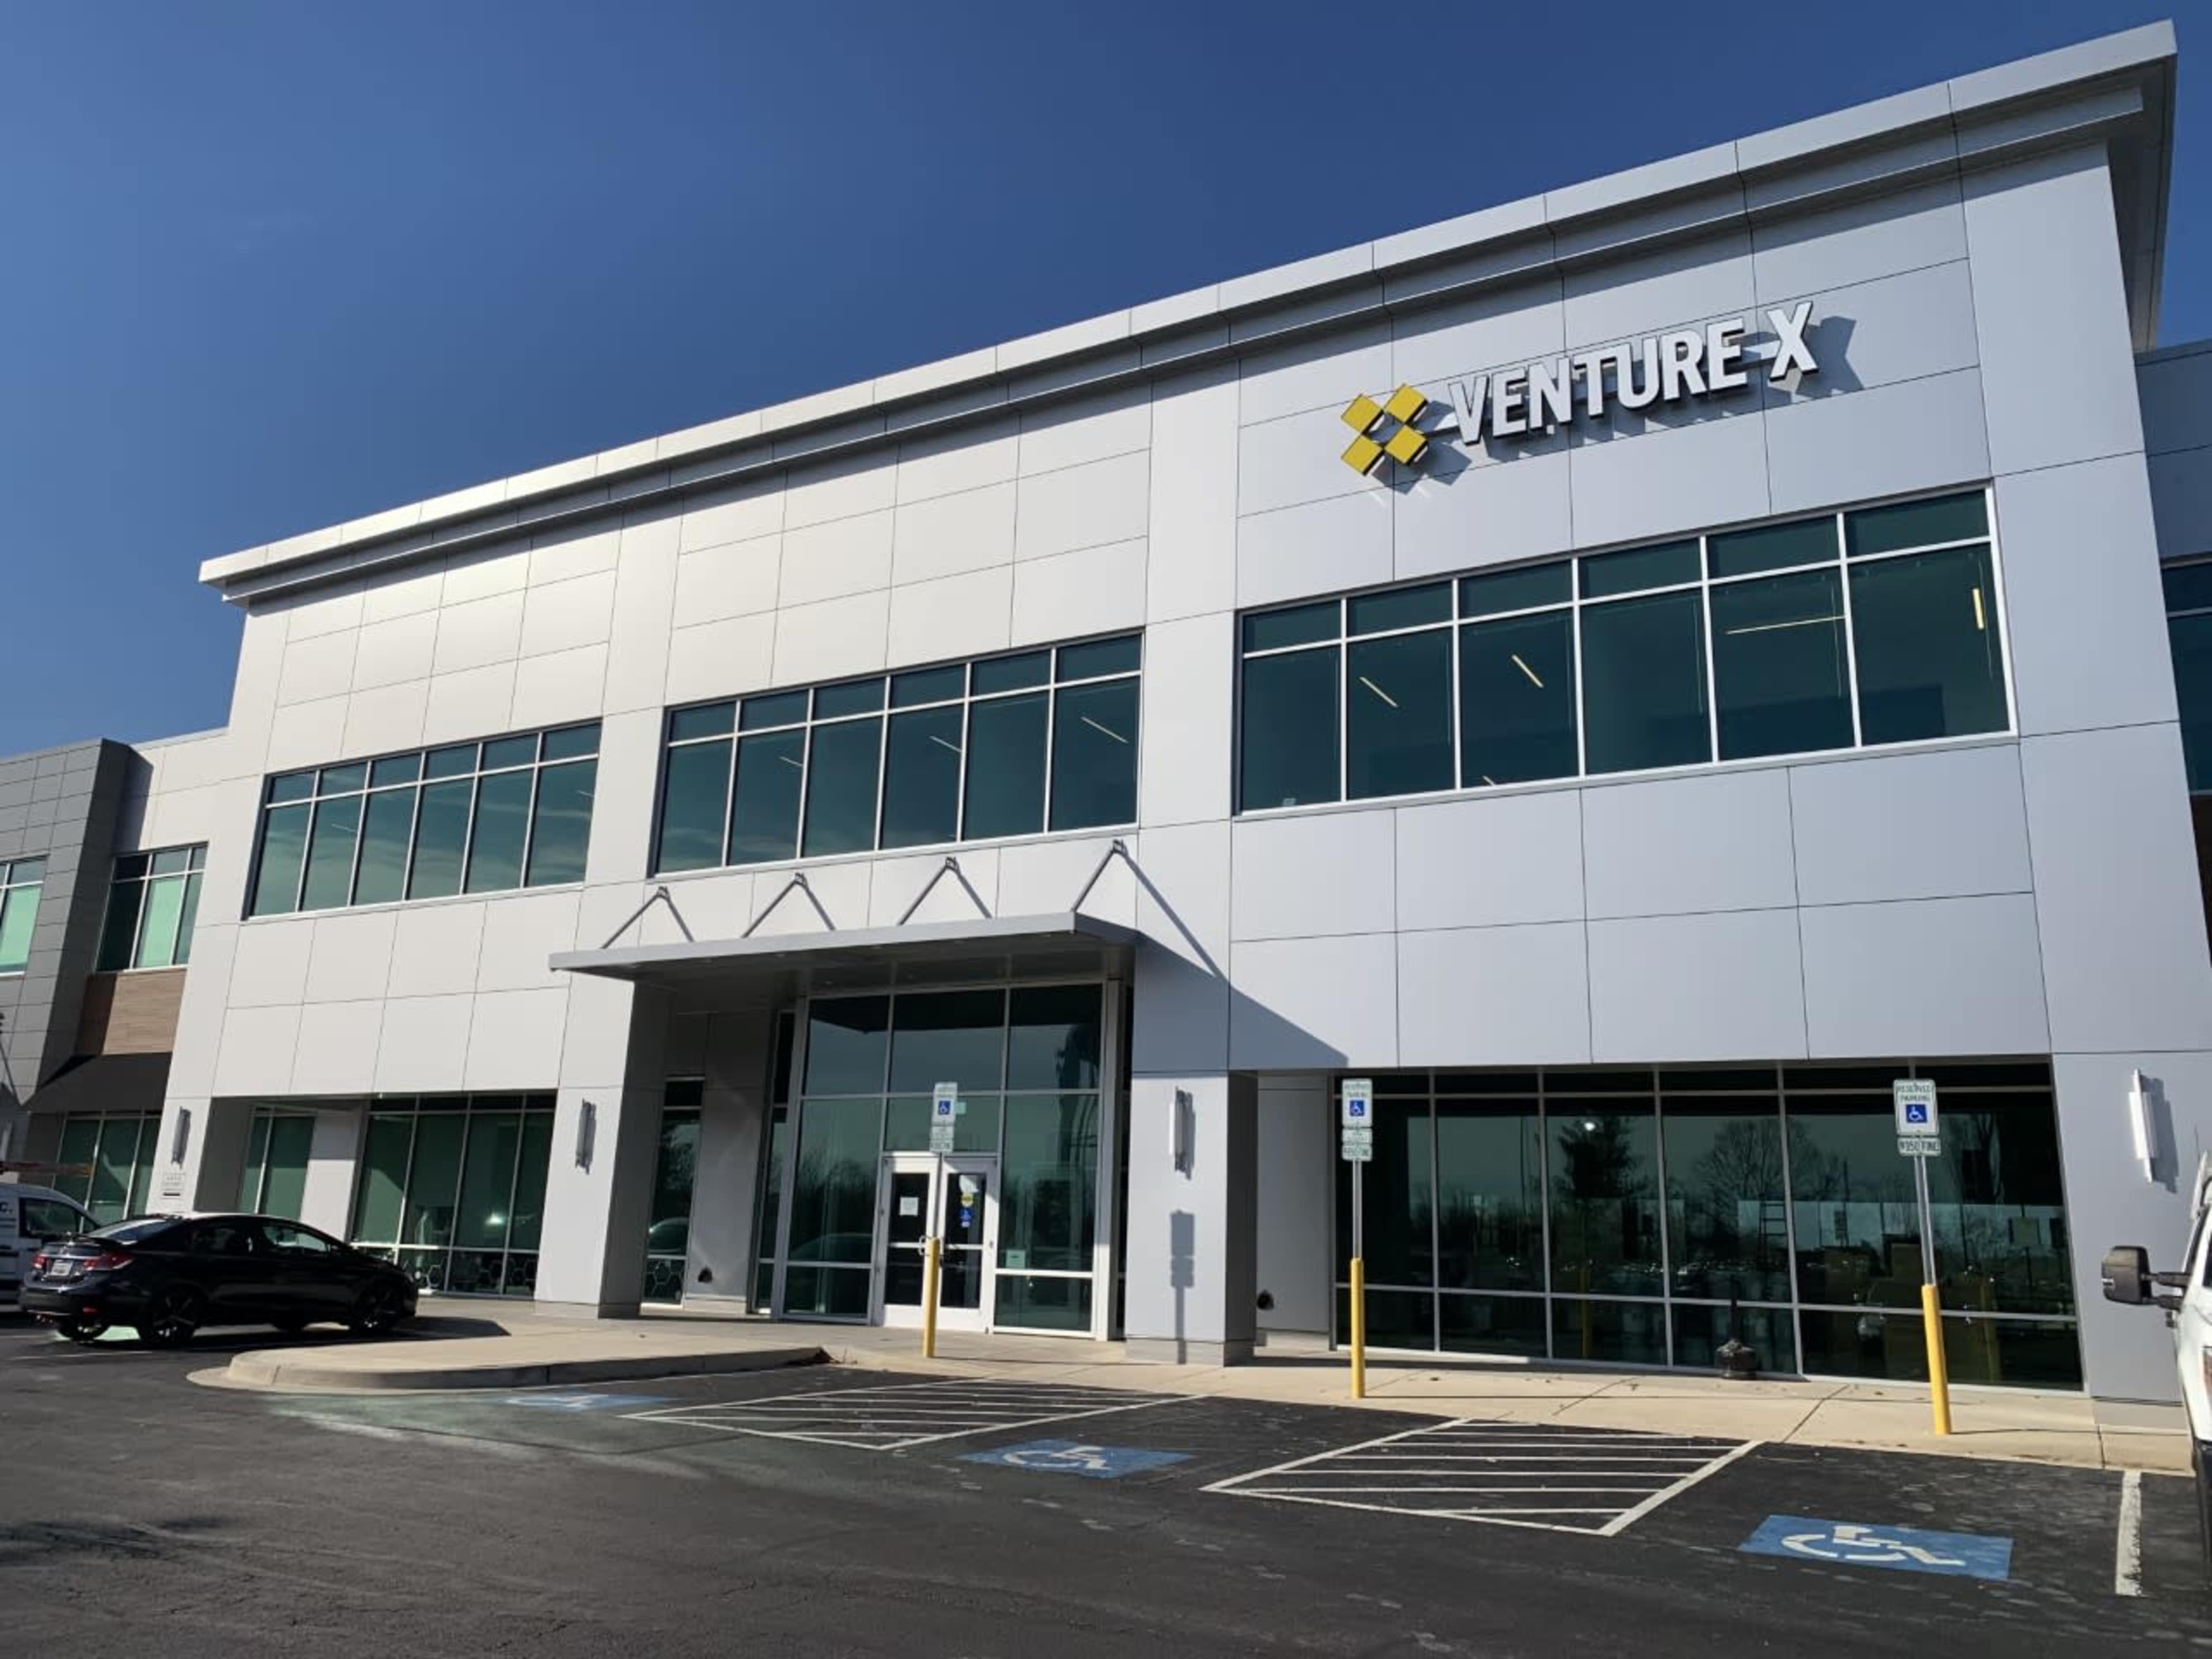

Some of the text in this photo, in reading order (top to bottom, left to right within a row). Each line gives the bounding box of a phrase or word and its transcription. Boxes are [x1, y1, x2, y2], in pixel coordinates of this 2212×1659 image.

[1448, 300, 1820, 446] VENTURE X
[1922, 1141, 1940, 1152] FINE
